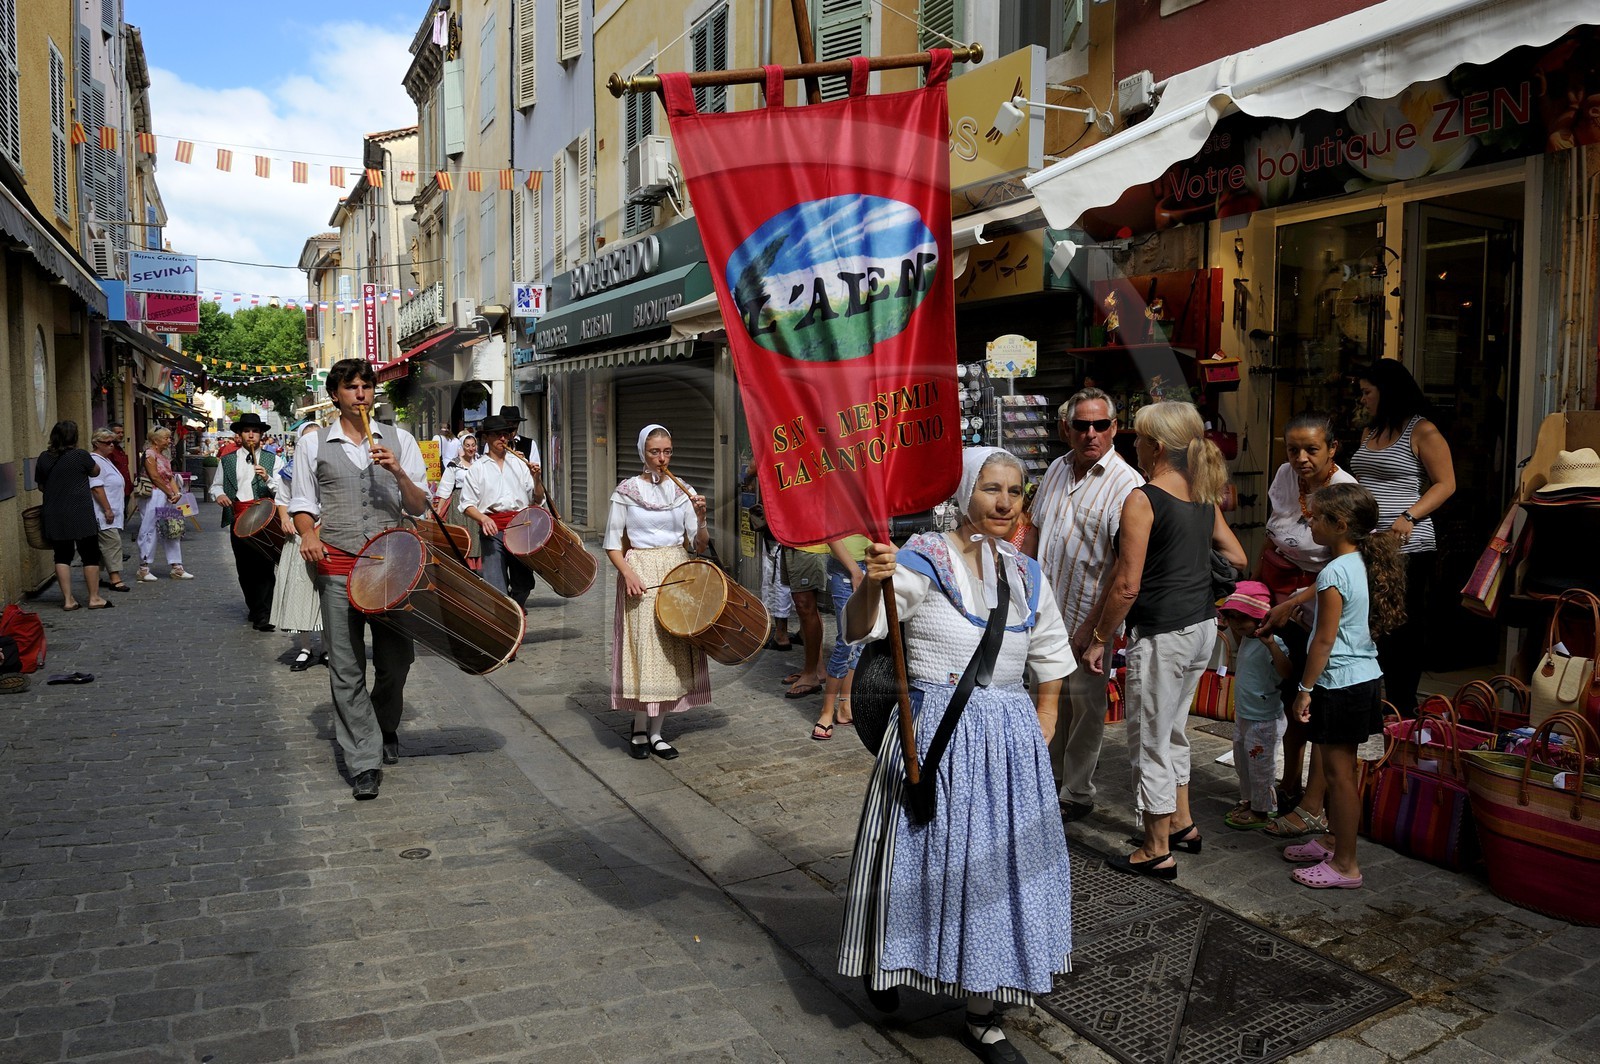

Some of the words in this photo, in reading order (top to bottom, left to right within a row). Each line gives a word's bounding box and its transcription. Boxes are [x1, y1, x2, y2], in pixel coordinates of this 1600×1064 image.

[1169, 164, 1246, 202] Votre
[1256, 121, 1417, 182] boutique
[1432, 81, 1531, 144] ZEN
[133, 265, 194, 283] SEVINA
[517, 287, 543, 309] NY
[742, 252, 938, 338] L'ALEN
[365, 286, 376, 361] @TERNET@
[536, 325, 567, 350] HORLOGER
[580, 313, 612, 341] ARTISAN
[774, 457, 813, 491] LA
